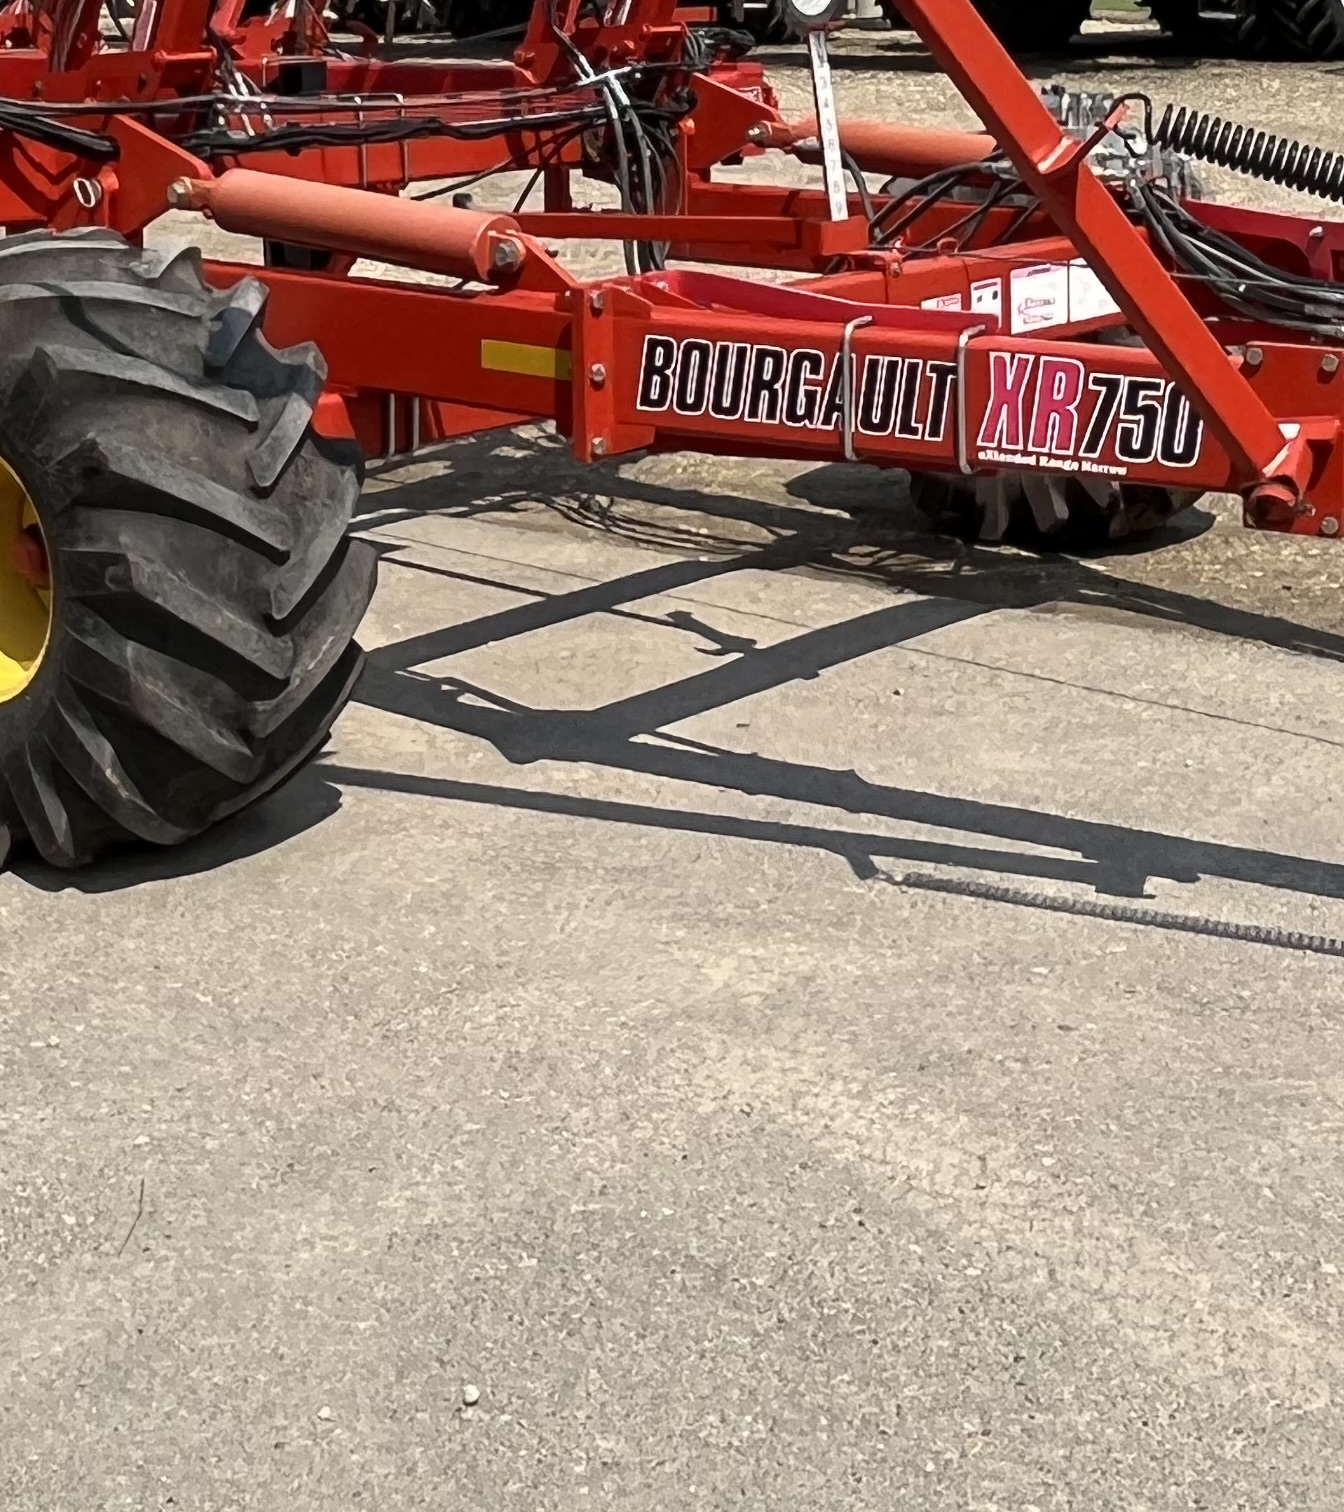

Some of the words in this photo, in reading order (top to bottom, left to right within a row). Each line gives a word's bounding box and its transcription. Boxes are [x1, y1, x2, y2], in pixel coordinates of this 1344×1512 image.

[636, 334, 959, 442] BOURGAULT
[1039, 455, 1079, 471] Range
[1081, 460, 1128, 476] Narrow
